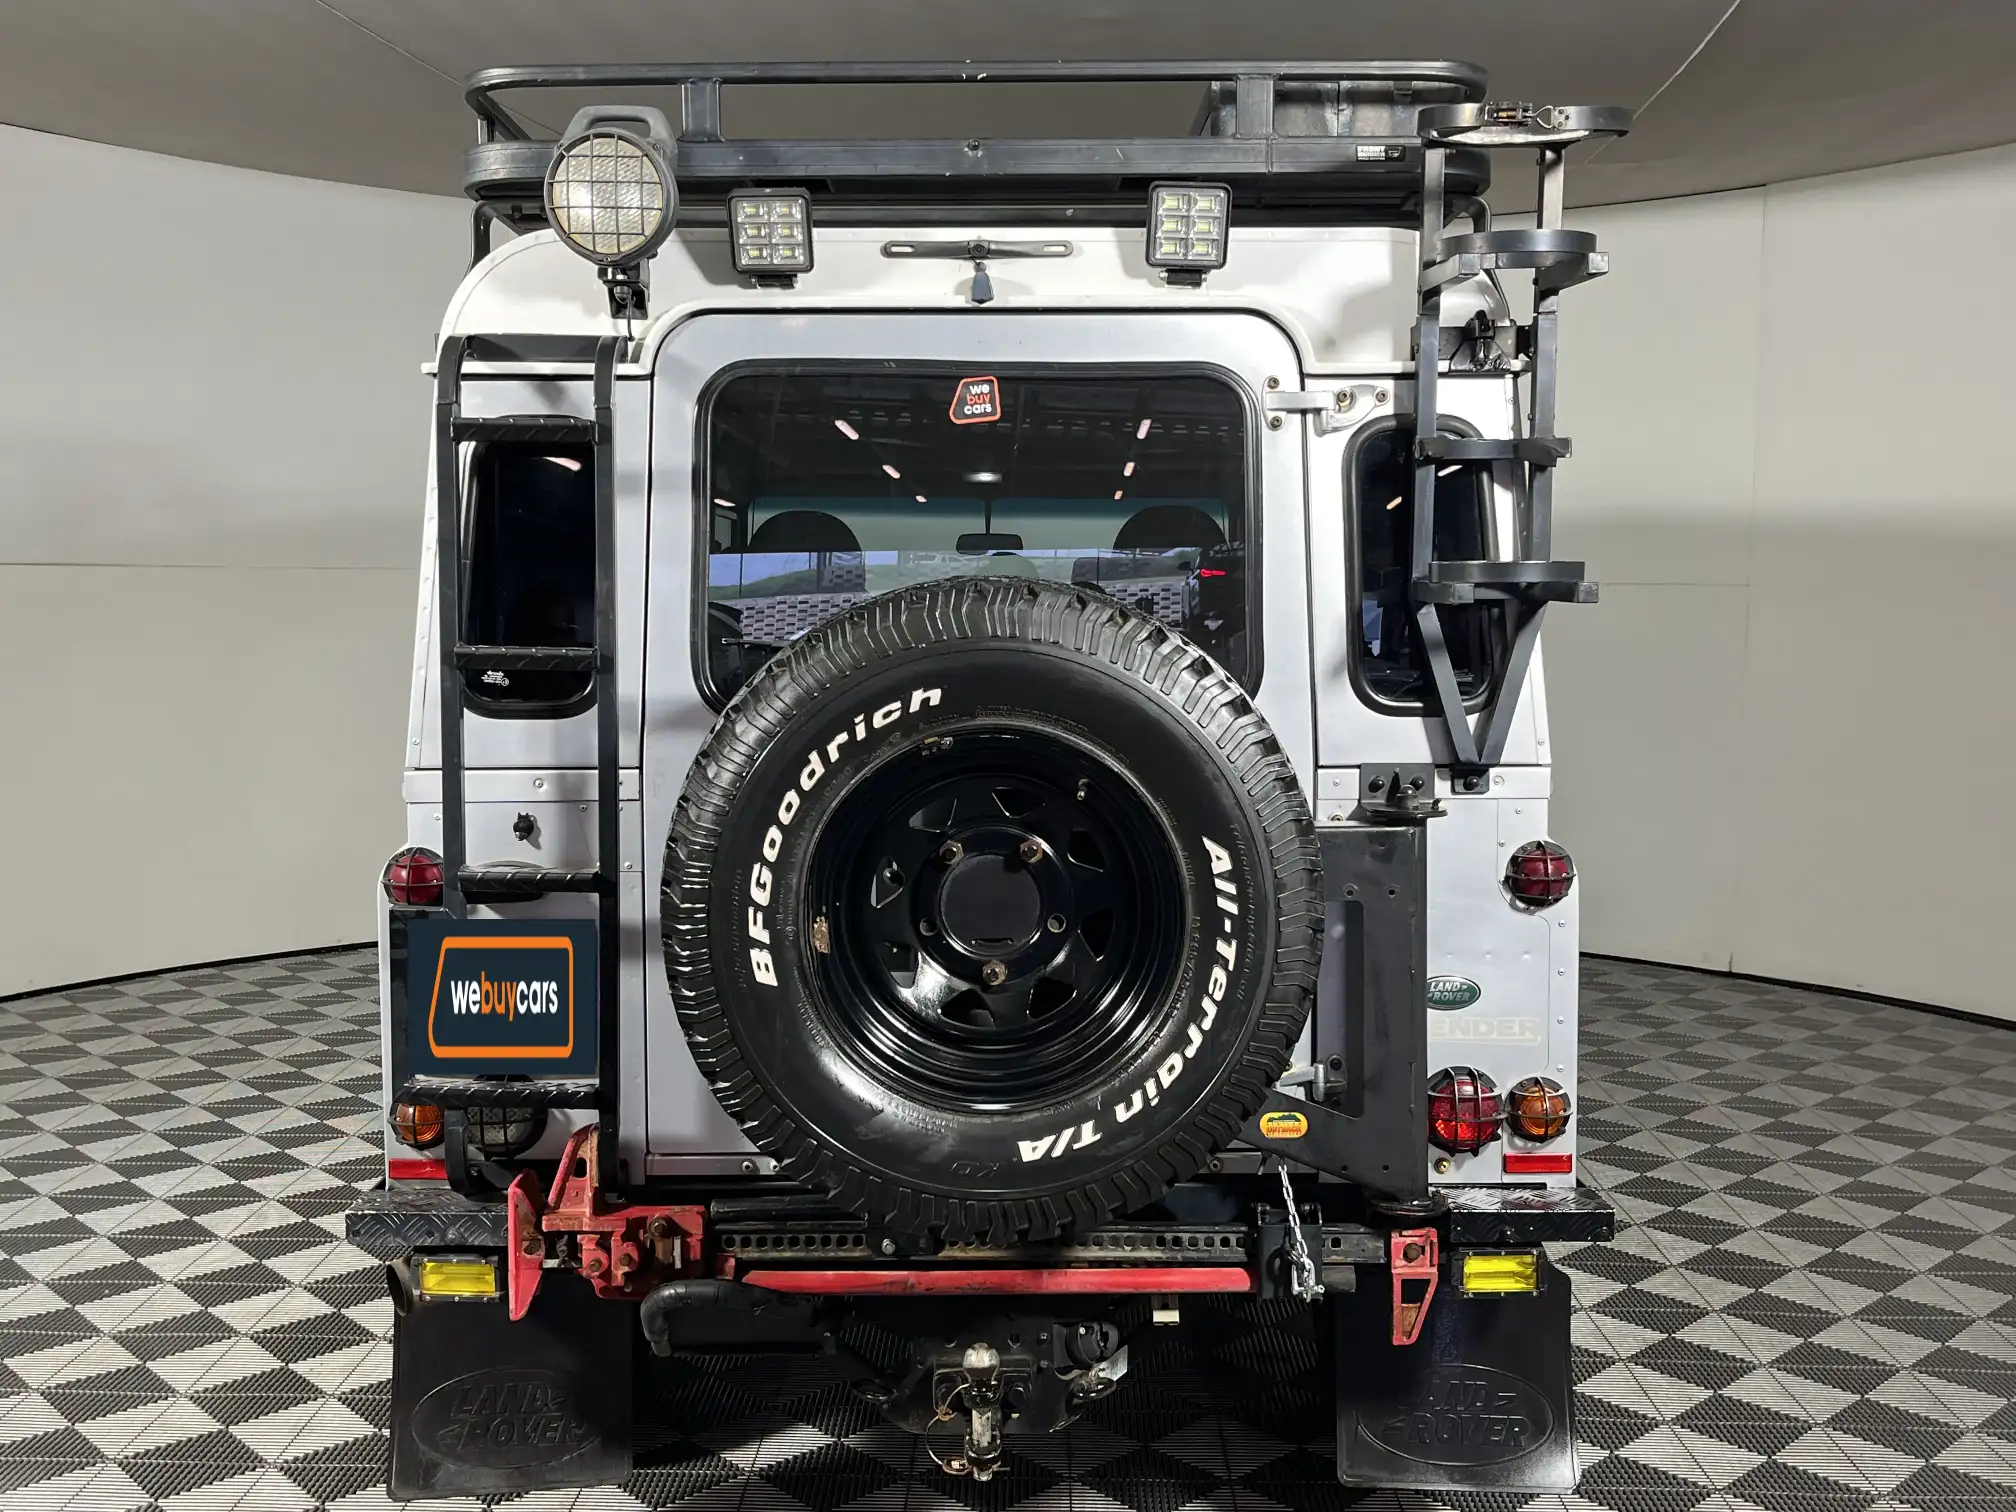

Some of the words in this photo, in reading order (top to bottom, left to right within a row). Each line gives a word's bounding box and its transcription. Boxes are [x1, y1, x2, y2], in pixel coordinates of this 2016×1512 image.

[966, 393, 991, 405] buy
[969, 384, 990, 395] we
[964, 403, 992, 415] cars
[748, 687, 942, 987] BFGoodrich
[1113, 836, 1239, 1124] All-Terrain
[1429, 981, 1461, 992] LAND
[1432, 991, 1471, 1001] ROVER
[1428, 1017, 1541, 1038] ENDER
[1017, 1119, 1102, 1162] T/A
[451, 1382, 551, 1416] LAND
[1397, 1380, 1489, 1411] AND
[1404, 1412, 1532, 1447] ROVER
